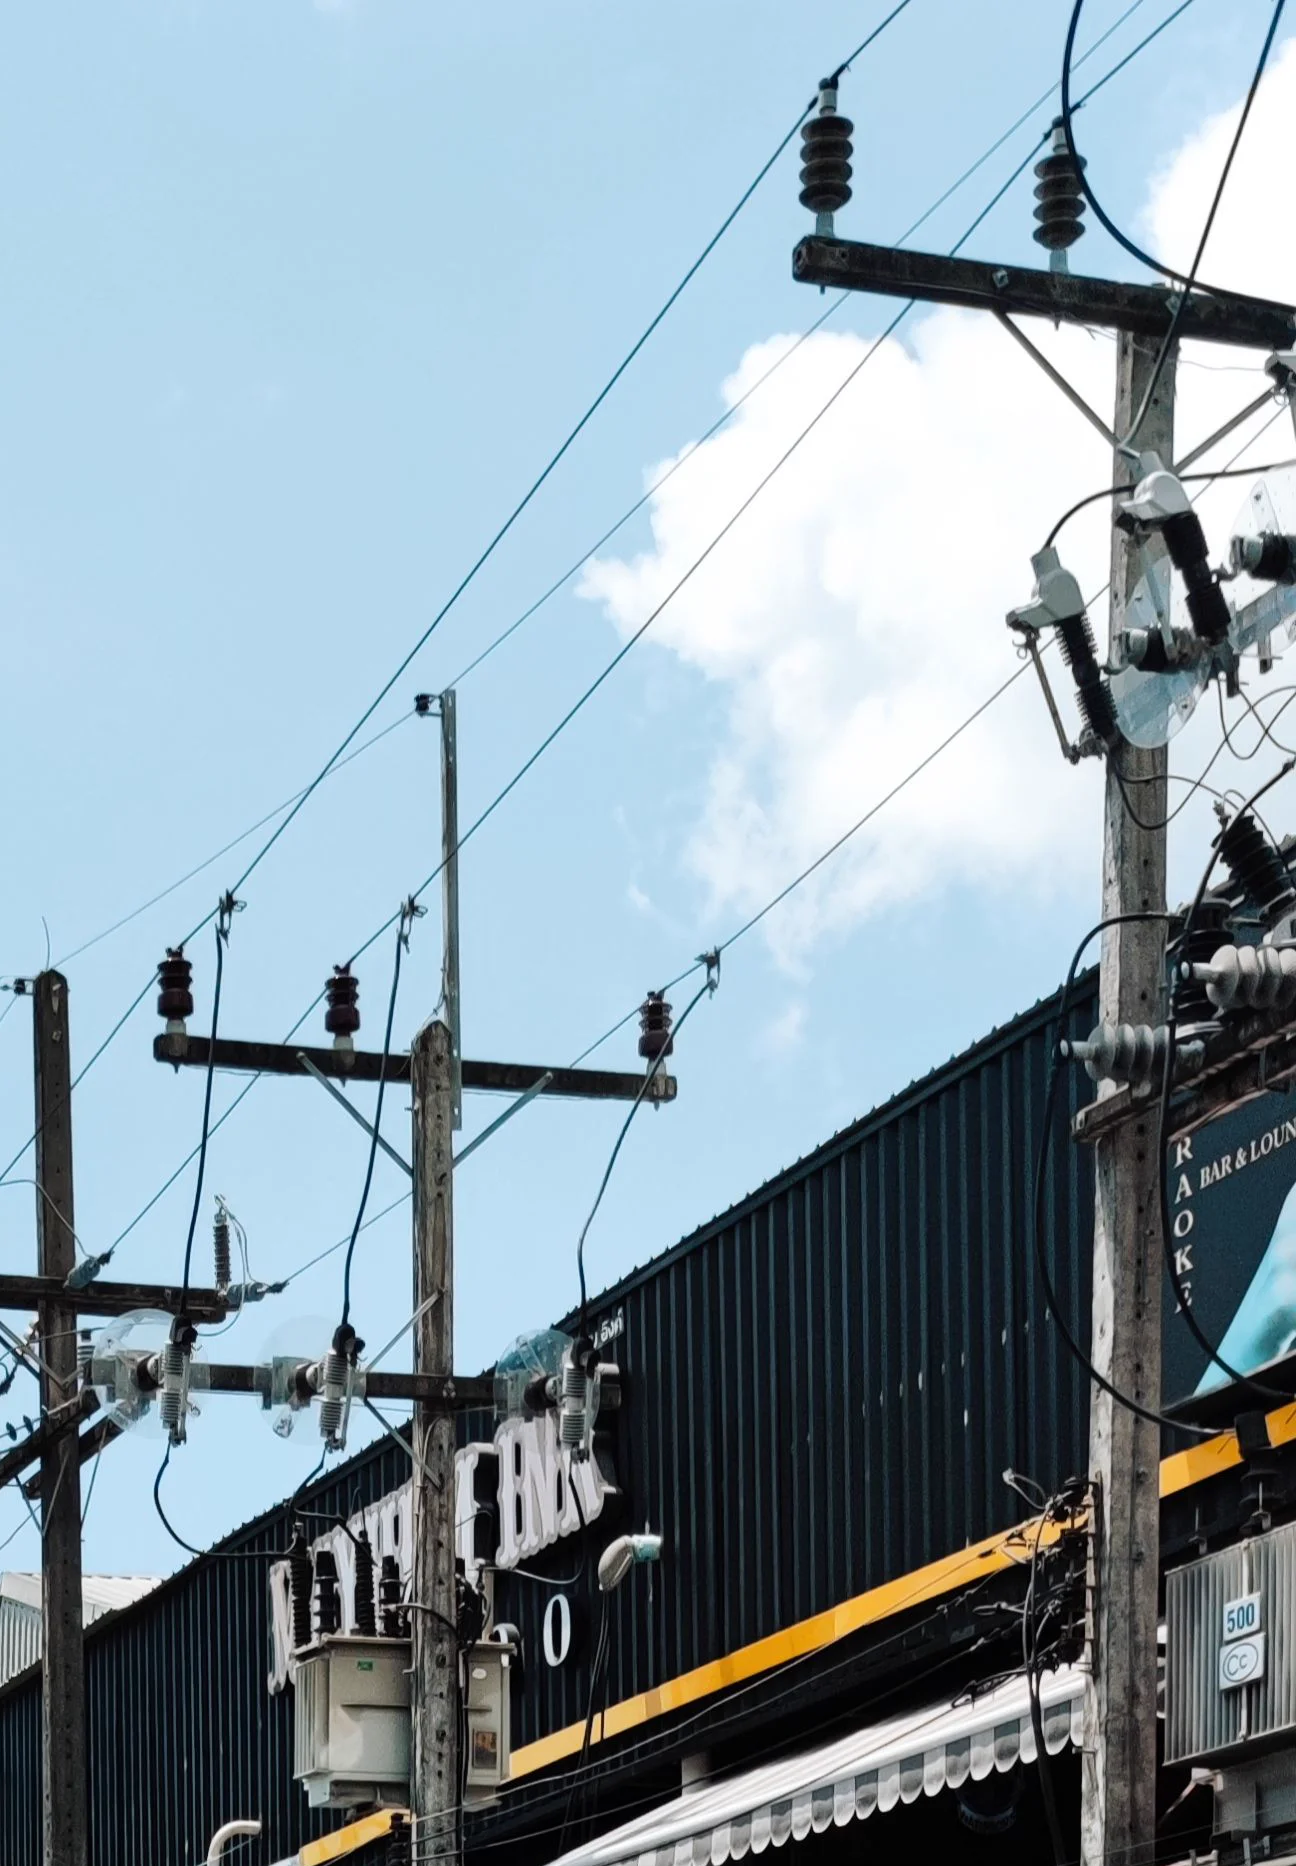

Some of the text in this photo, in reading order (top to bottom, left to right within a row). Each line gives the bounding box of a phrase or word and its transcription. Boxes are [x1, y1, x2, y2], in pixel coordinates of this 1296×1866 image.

[1198, 1155, 1231, 1189] BAR
[1235, 1147, 1248, 1170] &
[1226, 1602, 1255, 1632] 500
